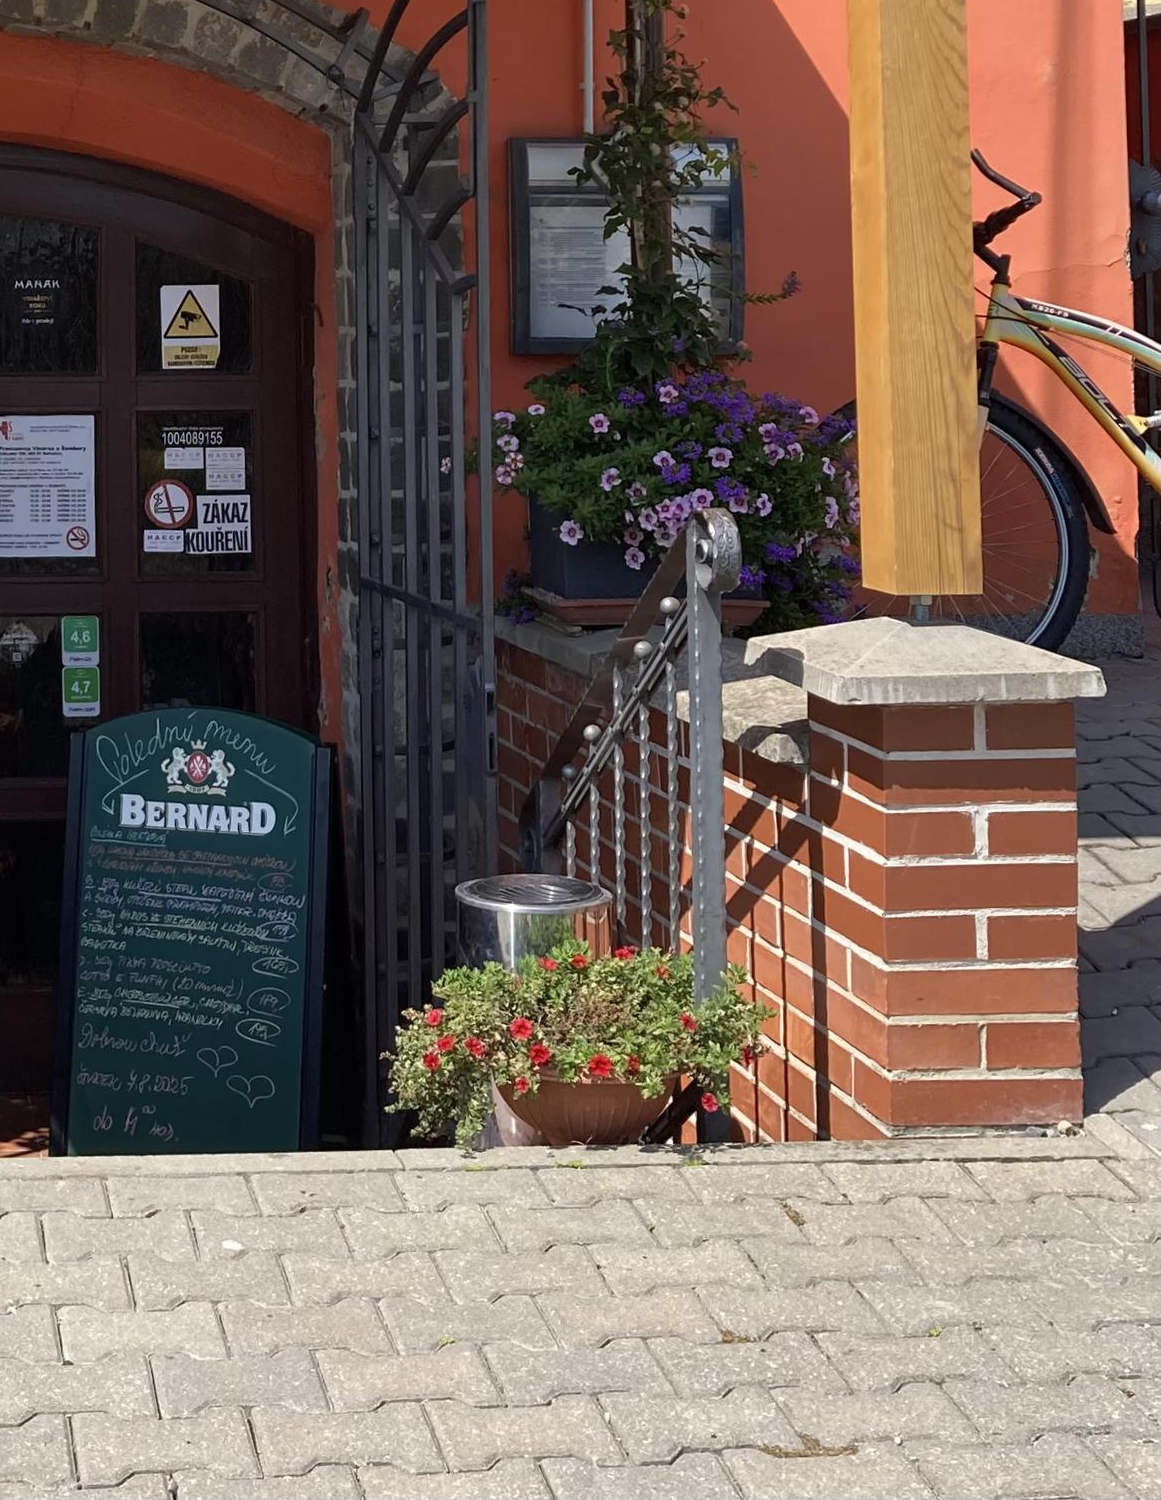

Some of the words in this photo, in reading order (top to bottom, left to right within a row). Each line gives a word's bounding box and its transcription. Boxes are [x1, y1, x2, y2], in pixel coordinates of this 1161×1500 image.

[161, 431, 223, 445] 1004089155
[203, 499, 249, 524] ZÁKAZ
[186, 526, 249, 552] KOUŘENÍ
[119, 793, 276, 835] BERNARD
[93, 1105, 113, 1131] do
